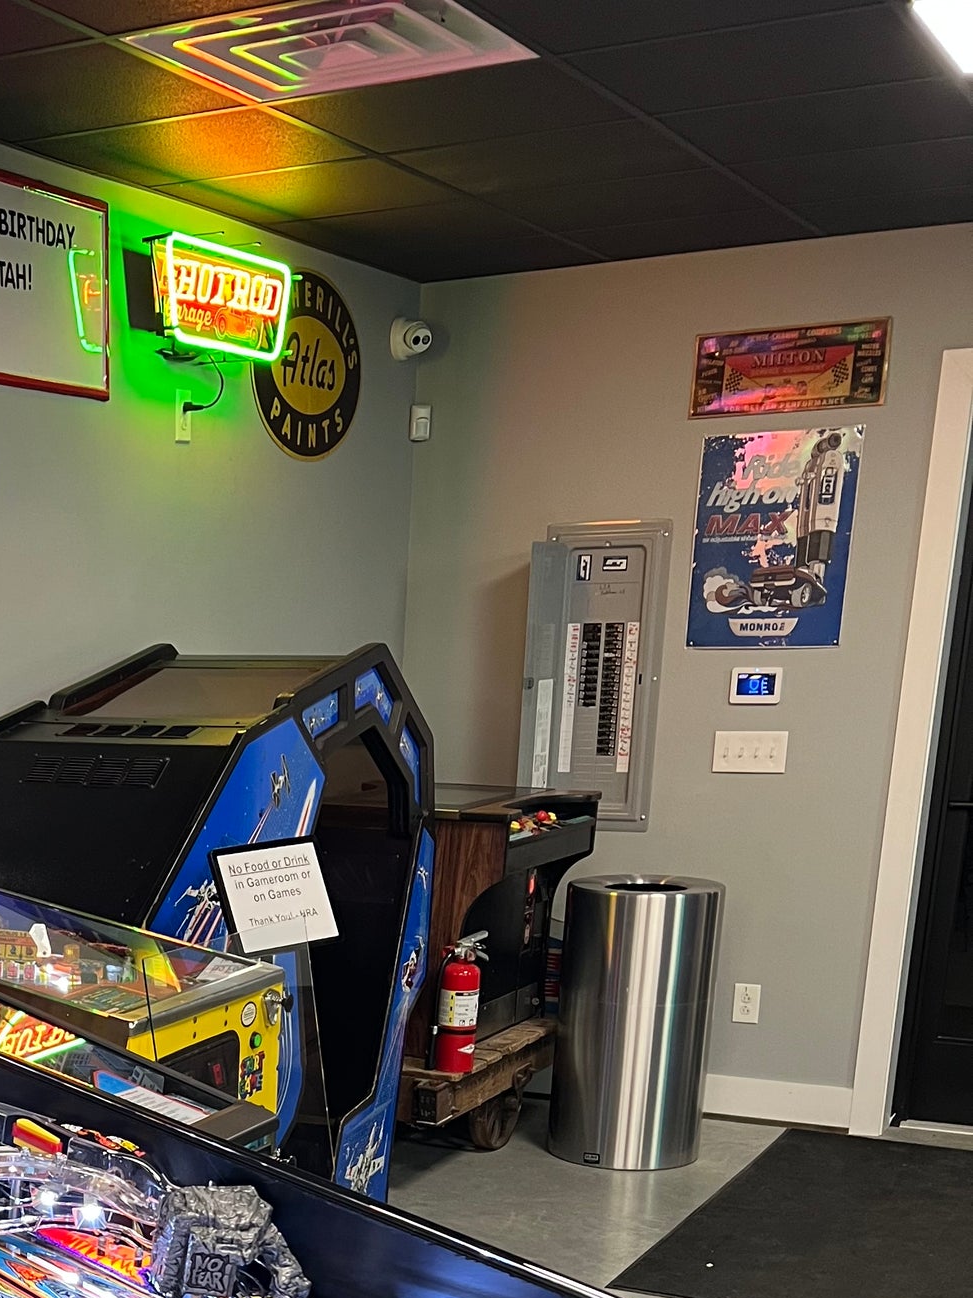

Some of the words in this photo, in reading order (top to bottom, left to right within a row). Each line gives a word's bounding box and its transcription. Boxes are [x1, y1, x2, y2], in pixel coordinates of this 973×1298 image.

[281, 331, 336, 391] Atlas
[751, 349, 826, 368] MILTON
[778, 397, 845, 409] PERFORMANCE
[270, 397, 343, 448] PAINTS
[743, 453, 801, 481] Ride
[705, 511, 795, 535] MAX
[739, 622, 786, 632] MONROE
[228, 864, 242, 875] No
[244, 861, 269, 872] Food
[272, 859, 282, 869] or
[283, 854, 309, 867] Drink
[235, 879, 245, 890] in
[247, 873, 299, 888] Gameroom
[301, 870, 311, 880] or
[253, 892, 266, 902] on
[267, 887, 302, 900] Games
[249, 915, 275, 927] Thank
[194, 1253, 223, 1271] NO
[191, 1268, 224, 1292] FEAR
